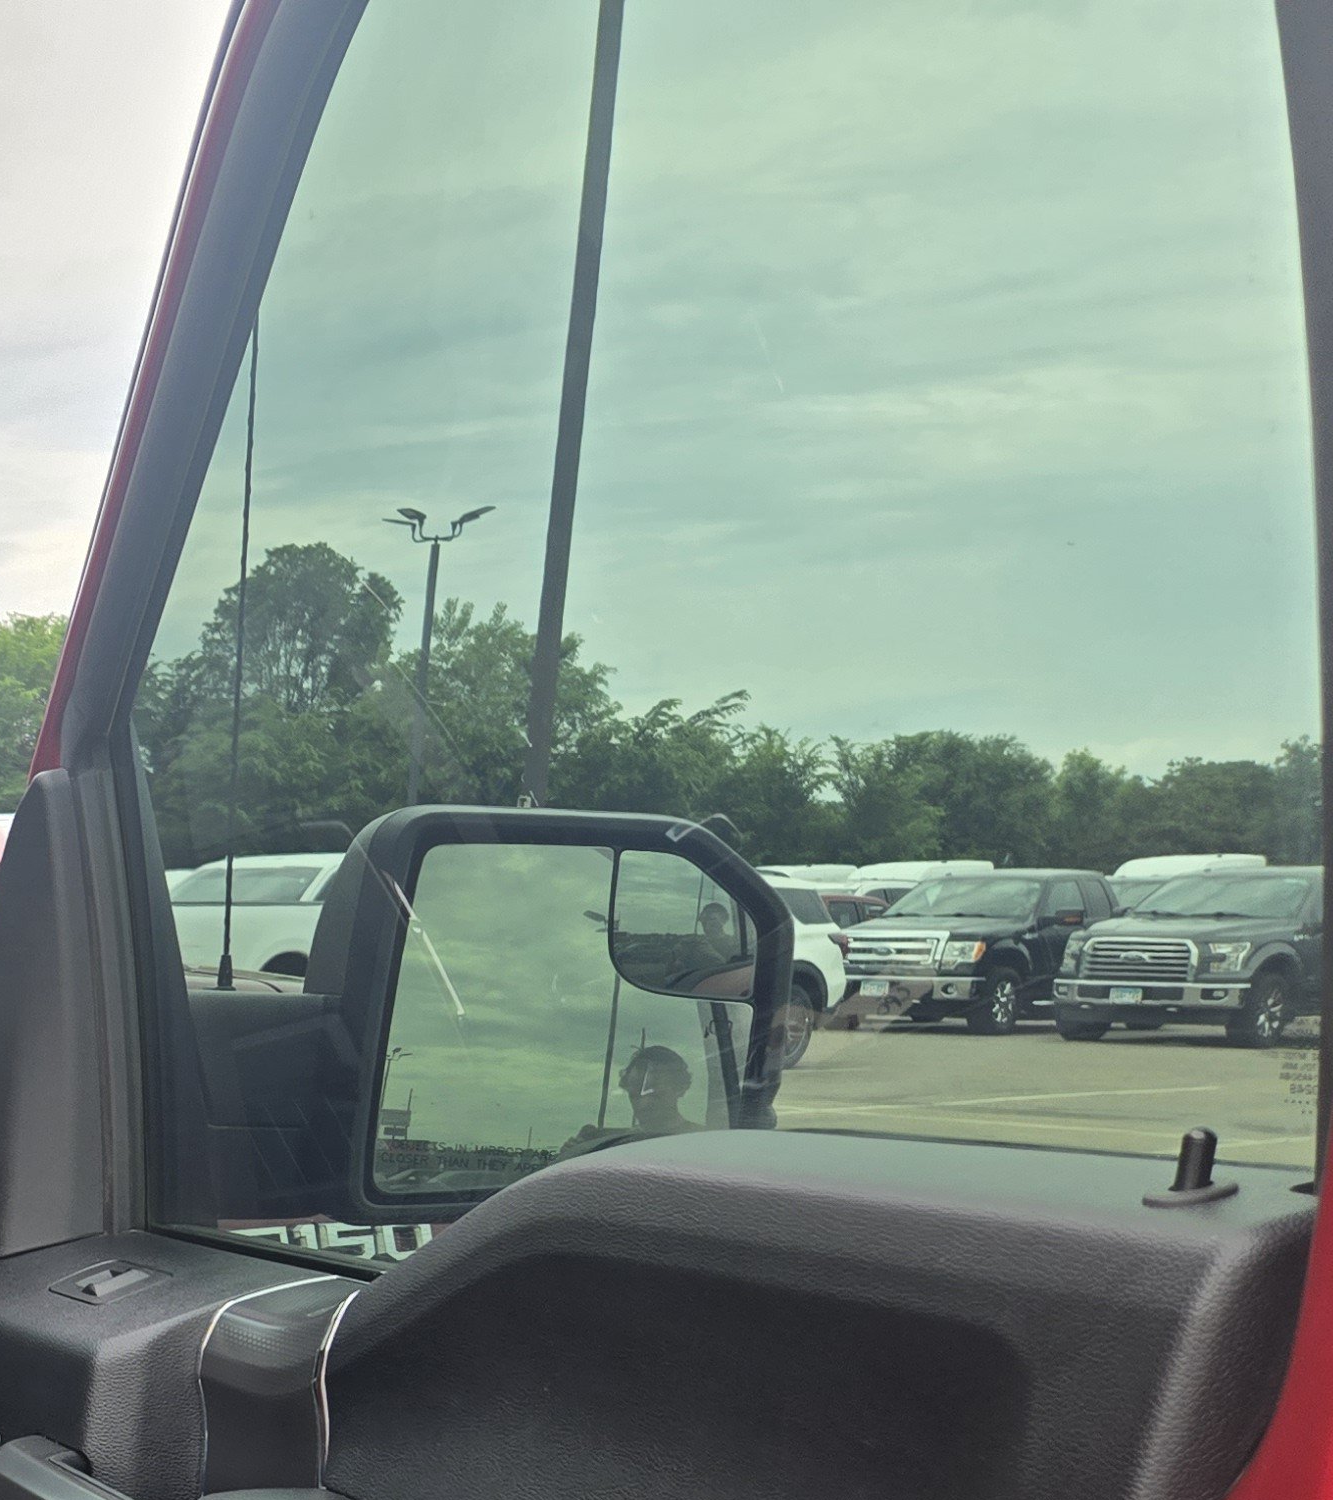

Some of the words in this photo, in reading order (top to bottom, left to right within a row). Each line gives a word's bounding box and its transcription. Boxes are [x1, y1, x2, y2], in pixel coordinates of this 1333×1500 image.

[381, 1150, 429, 1164] CLOSER
[437, 1155, 470, 1168] THAN
[477, 1158, 507, 1170] THEY
